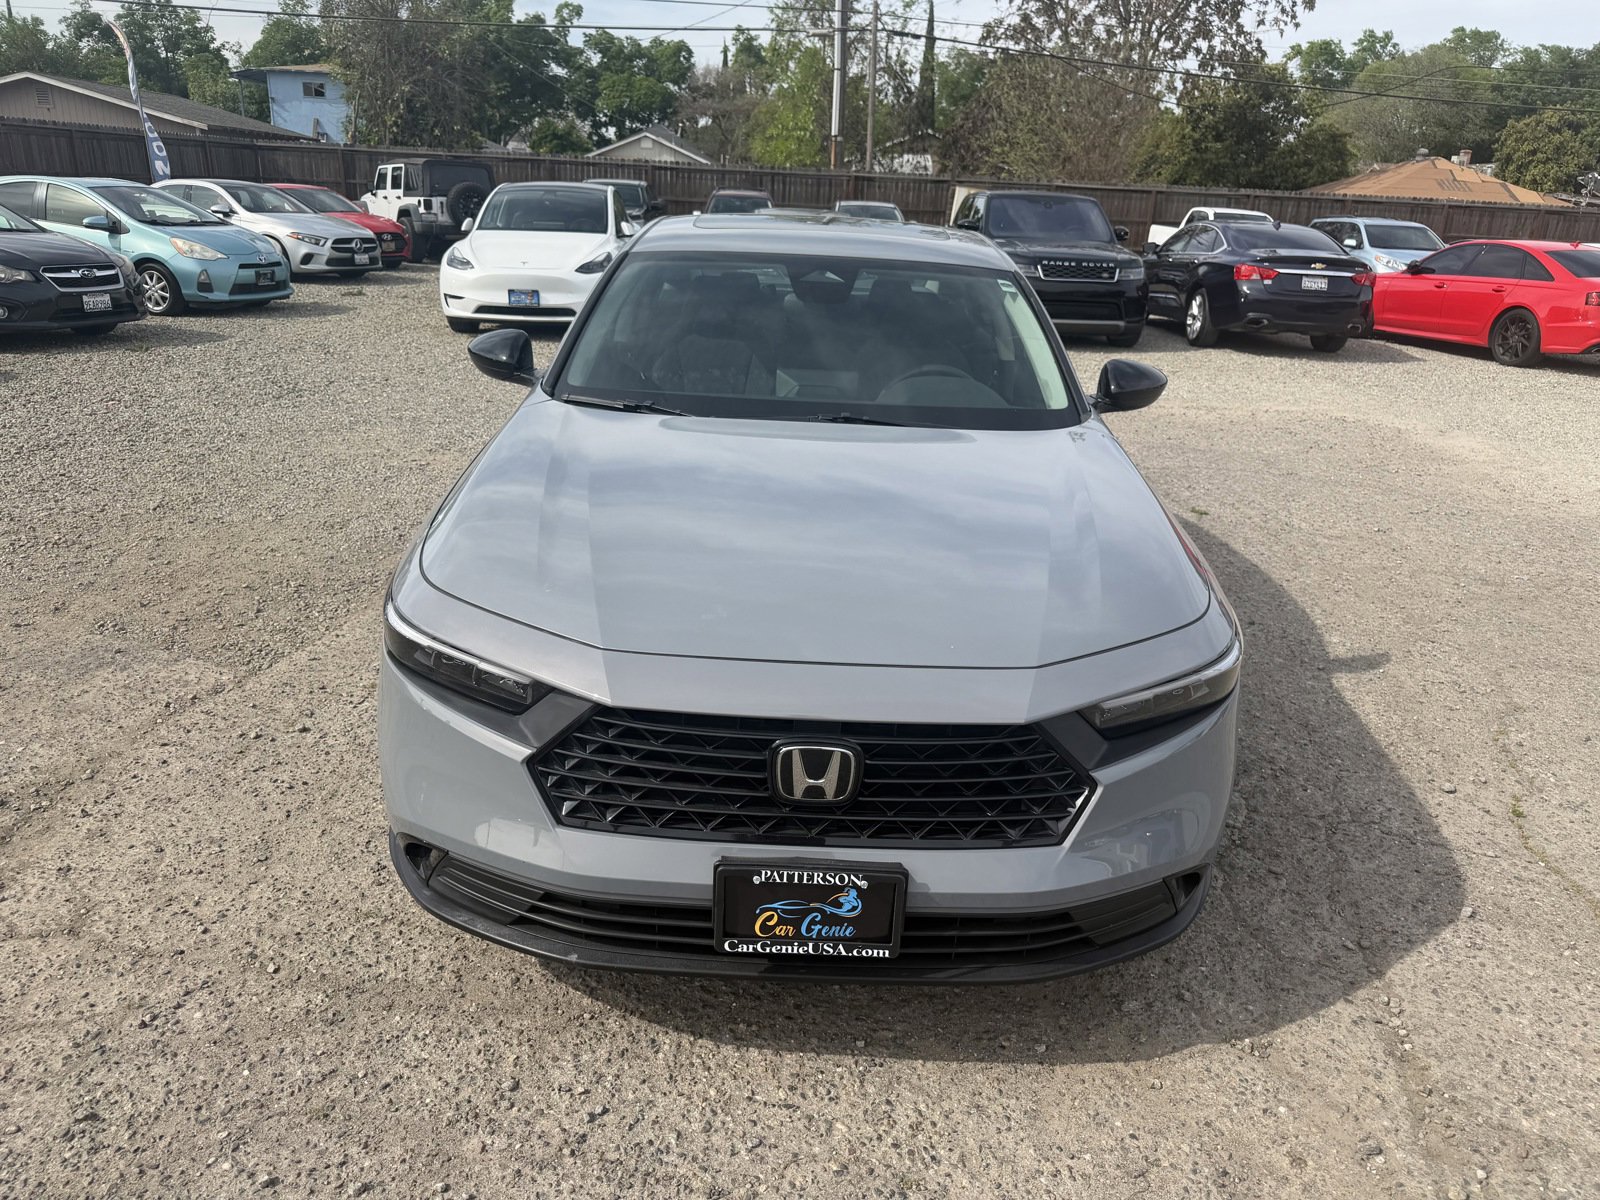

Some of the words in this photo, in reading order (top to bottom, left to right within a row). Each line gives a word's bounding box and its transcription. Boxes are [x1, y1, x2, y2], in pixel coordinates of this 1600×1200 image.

[761, 869, 863, 886] PATTERSON
[755, 911, 796, 937] Car
[801, 912, 856, 938] Genie
[724, 940, 890, 957] CarGenieUSA.com
